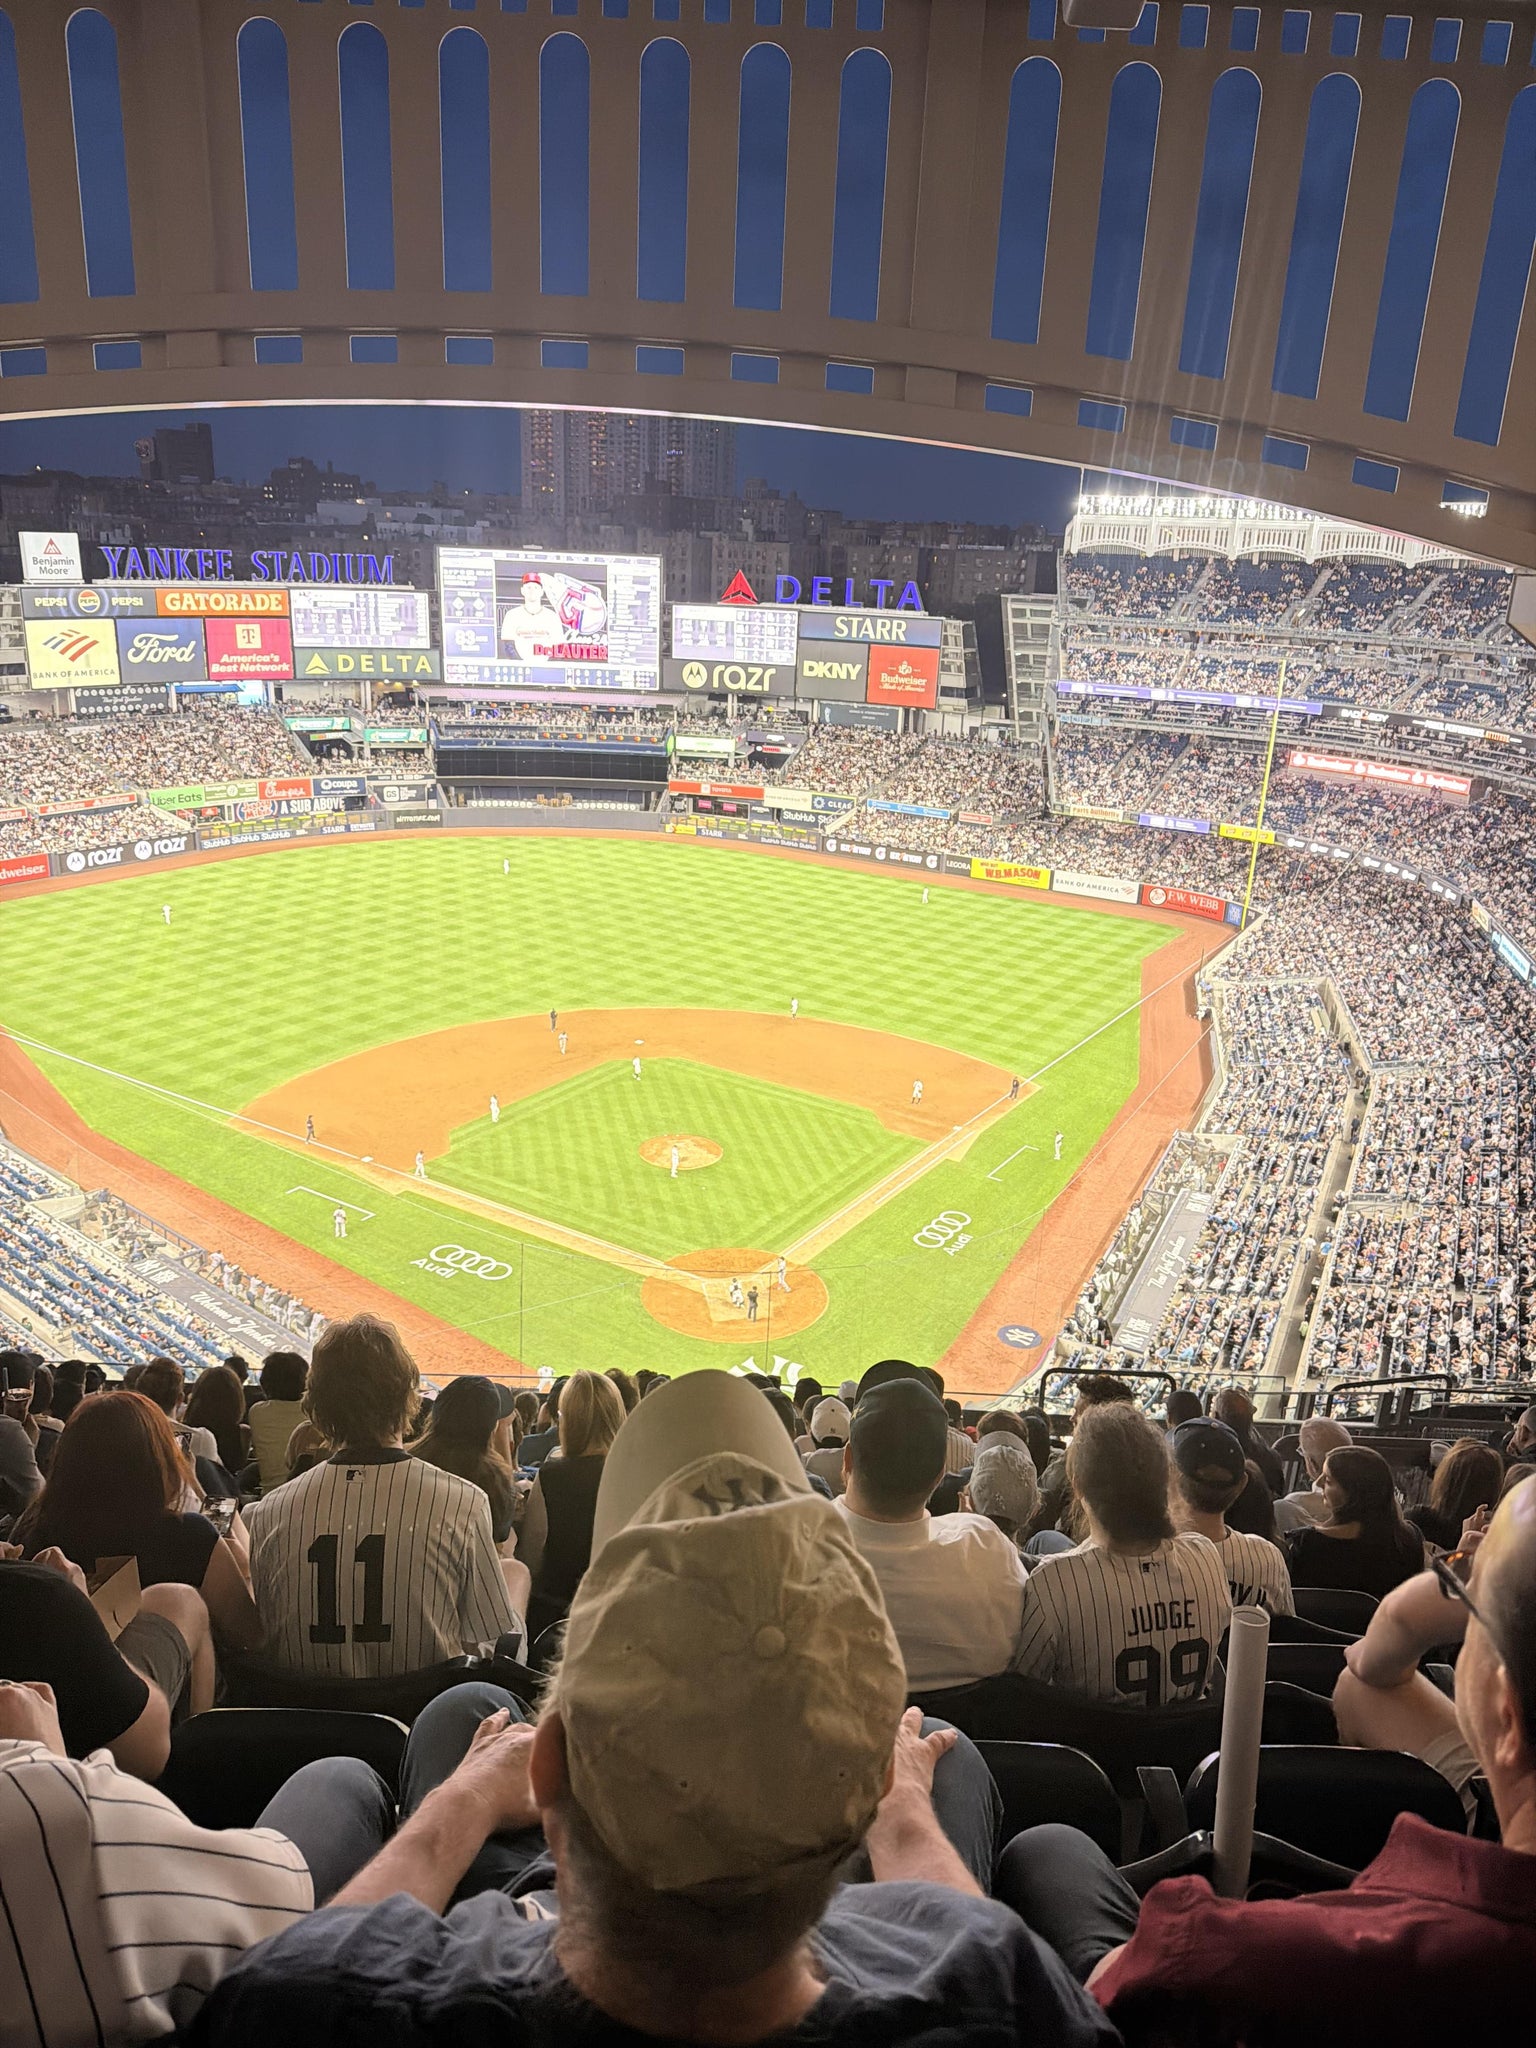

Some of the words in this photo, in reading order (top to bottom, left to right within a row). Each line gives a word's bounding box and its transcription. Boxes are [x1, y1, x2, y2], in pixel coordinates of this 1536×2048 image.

[32, 557, 75, 567] Benjamin
[98, 546, 233, 581] YANKEE
[251, 551, 395, 585] STADIUM
[39, 567, 69, 575] Moore
[774, 574, 924, 612] DELTA
[34, 598, 67, 606] PEPSI
[111, 597, 144, 606] PEPSI
[164, 592, 283, 611] GATORADE
[242, 627, 255, 643] T
[834, 616, 907, 641] STARR
[127, 633, 197, 663] Ford
[219, 653, 280, 663] America's
[337, 654, 433, 673] DELTA
[32, 672, 58, 680] BANK
[74, 668, 116, 677] AMERICA
[211, 663, 237, 673] Best
[239, 662, 290, 673] Network
[802, 660, 862, 680] DKNY
[712, 664, 776, 692] razr
[879, 672, 927, 686] Budweiser
[332, 781, 358, 790] coupa
[153, 796, 176, 806] Uber
[178, 792, 202, 804] Eats
[386, 790, 397, 798] GS
[280, 802, 289, 815] A
[290, 799, 312, 813] SUB
[313, 797, 345, 812] ABOVE
[783, 811, 816, 823] StubHub
[261, 830, 291, 841] StubHub
[322, 824, 348, 834] STARR
[701, 829, 723, 837] STARR
[154, 836, 188, 855] razr
[87, 847, 124, 866] razr
[1055, 878, 1075, 887] BANK
[1086, 883, 1119, 894] AMERICA
[1189, 895, 1219, 910] WEBB
[943, 1232, 974, 1257] Audi
[409, 1258, 459, 1279] Audi
[307, 1533, 392, 1644] 11
[1127, 1600, 1195, 1637] JUDGE
[1114, 1637, 1210, 1707] 99
